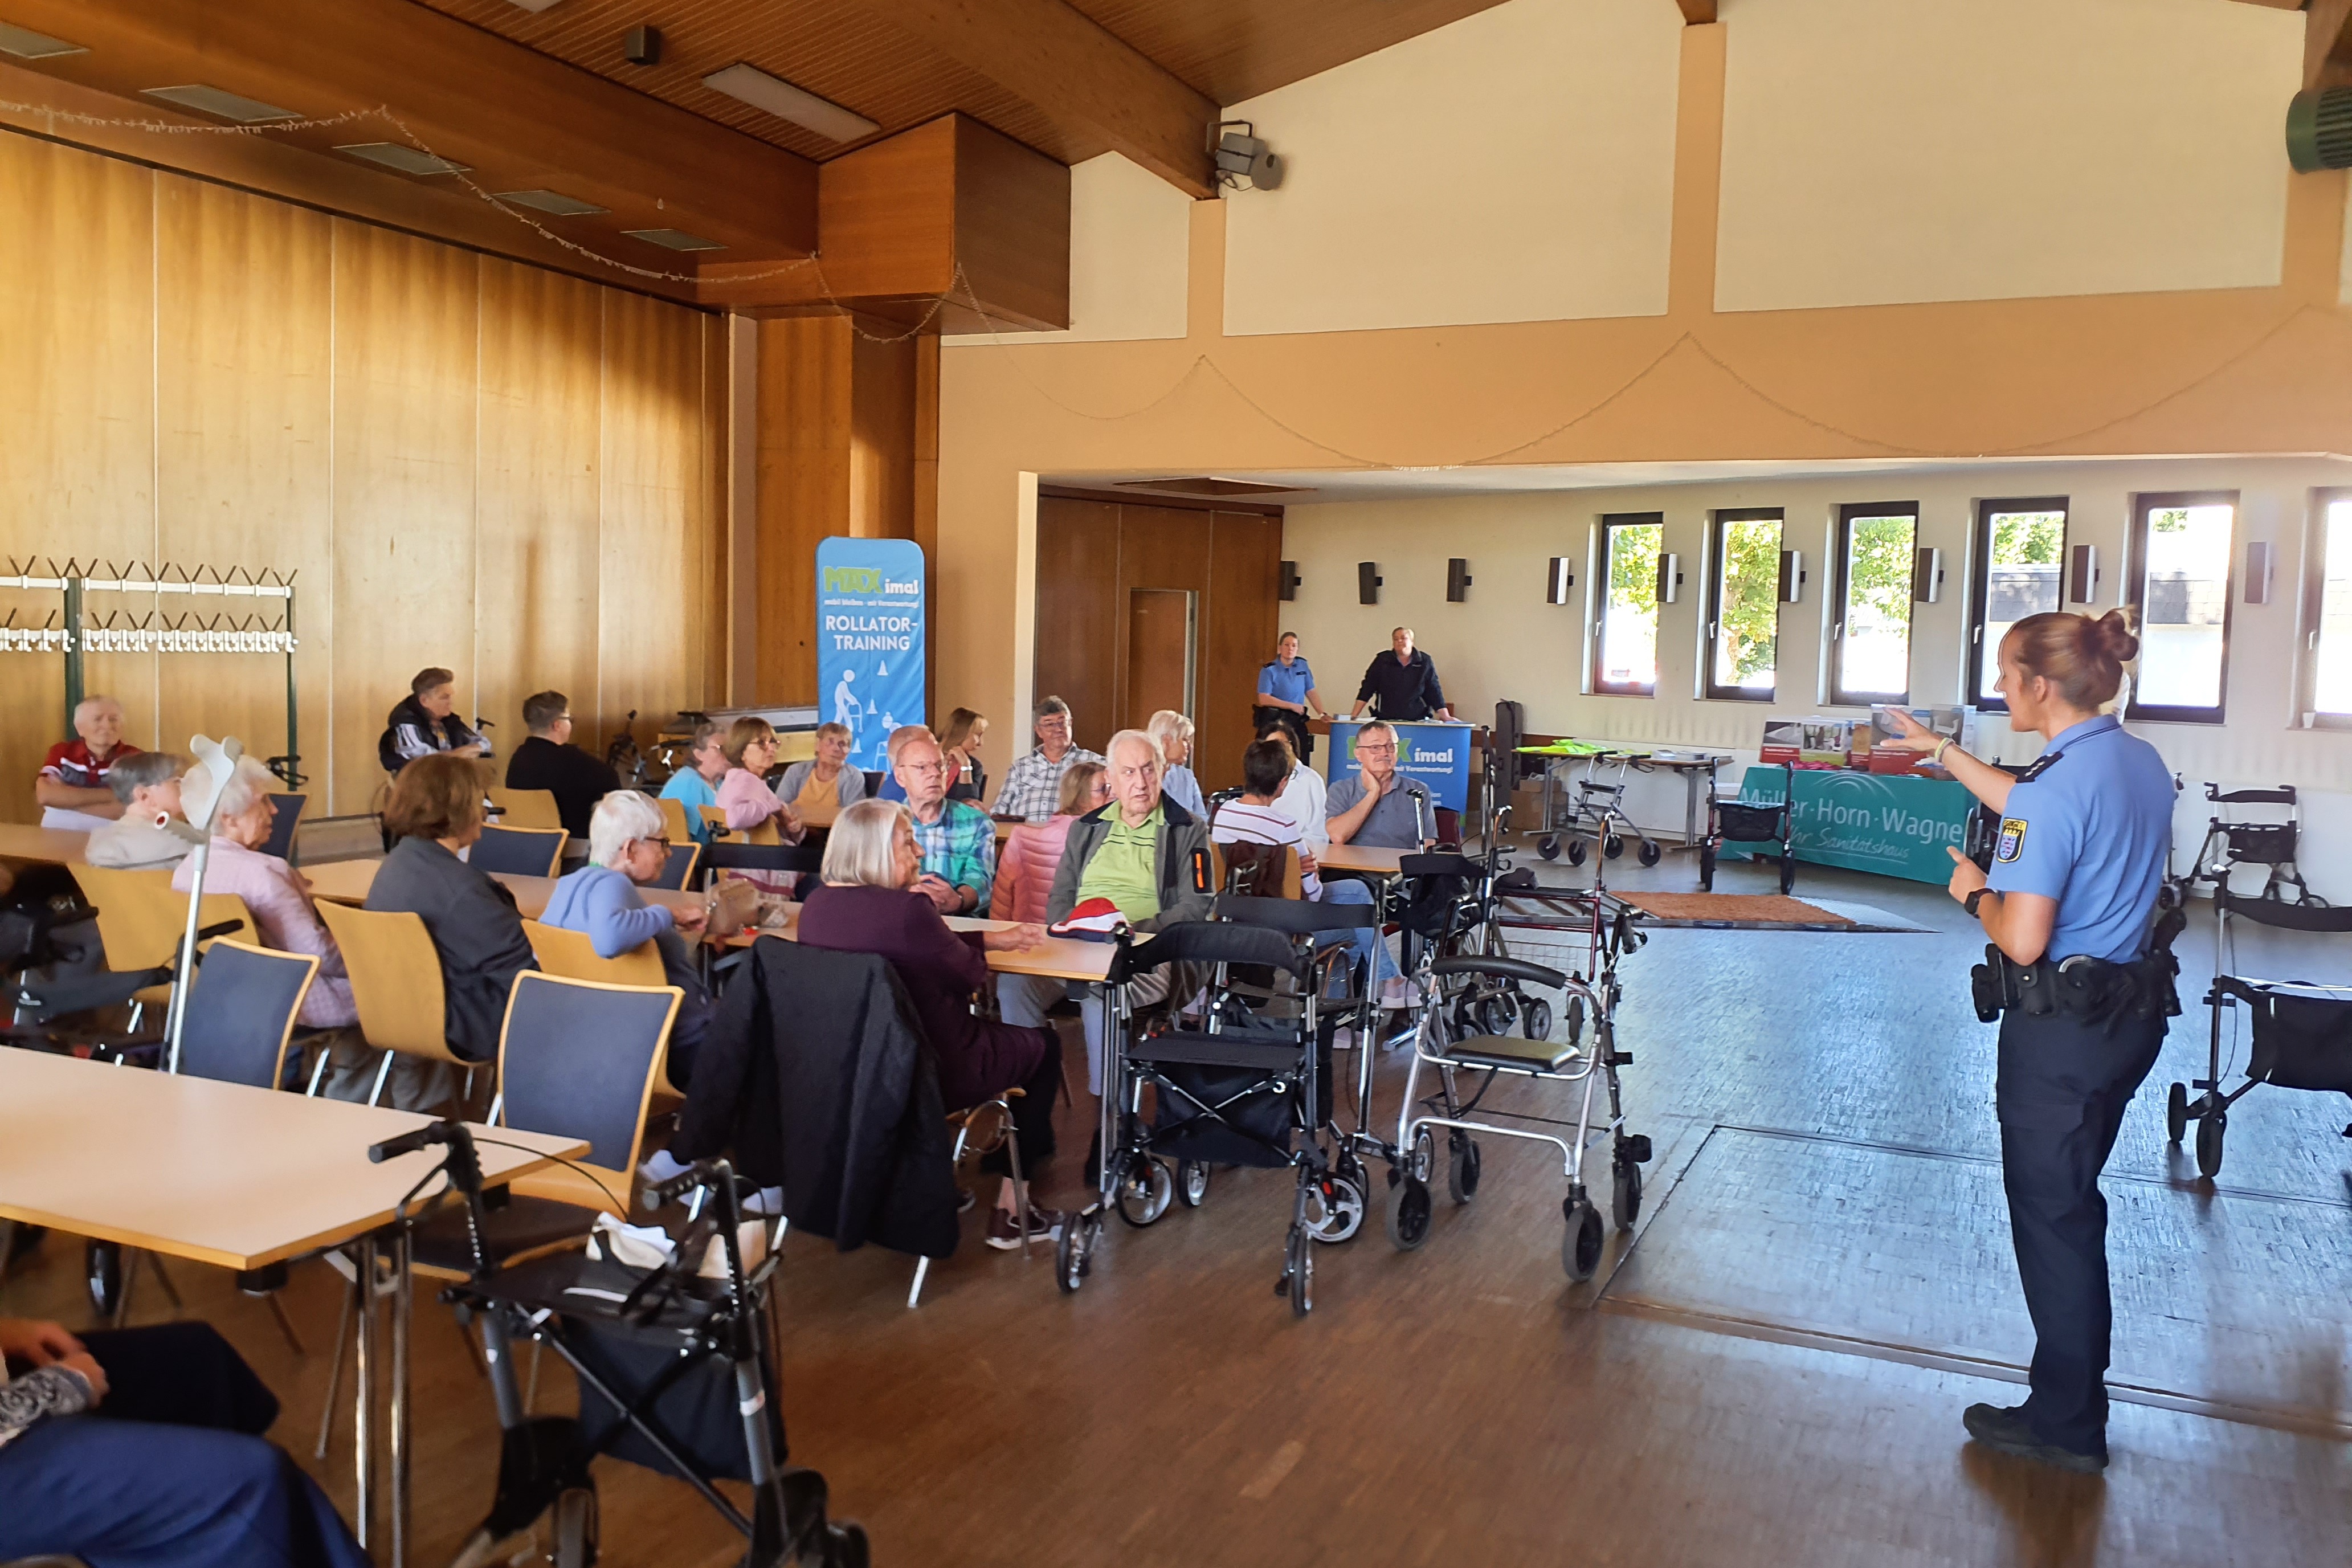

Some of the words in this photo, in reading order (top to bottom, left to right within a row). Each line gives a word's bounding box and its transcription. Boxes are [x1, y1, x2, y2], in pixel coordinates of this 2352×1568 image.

[826, 615, 918, 631] ROLLATOR-
[834, 635, 910, 651] TRAINING
[1414, 748, 1453, 763] imal
[1816, 827, 1910, 858] Sanitätshaus
